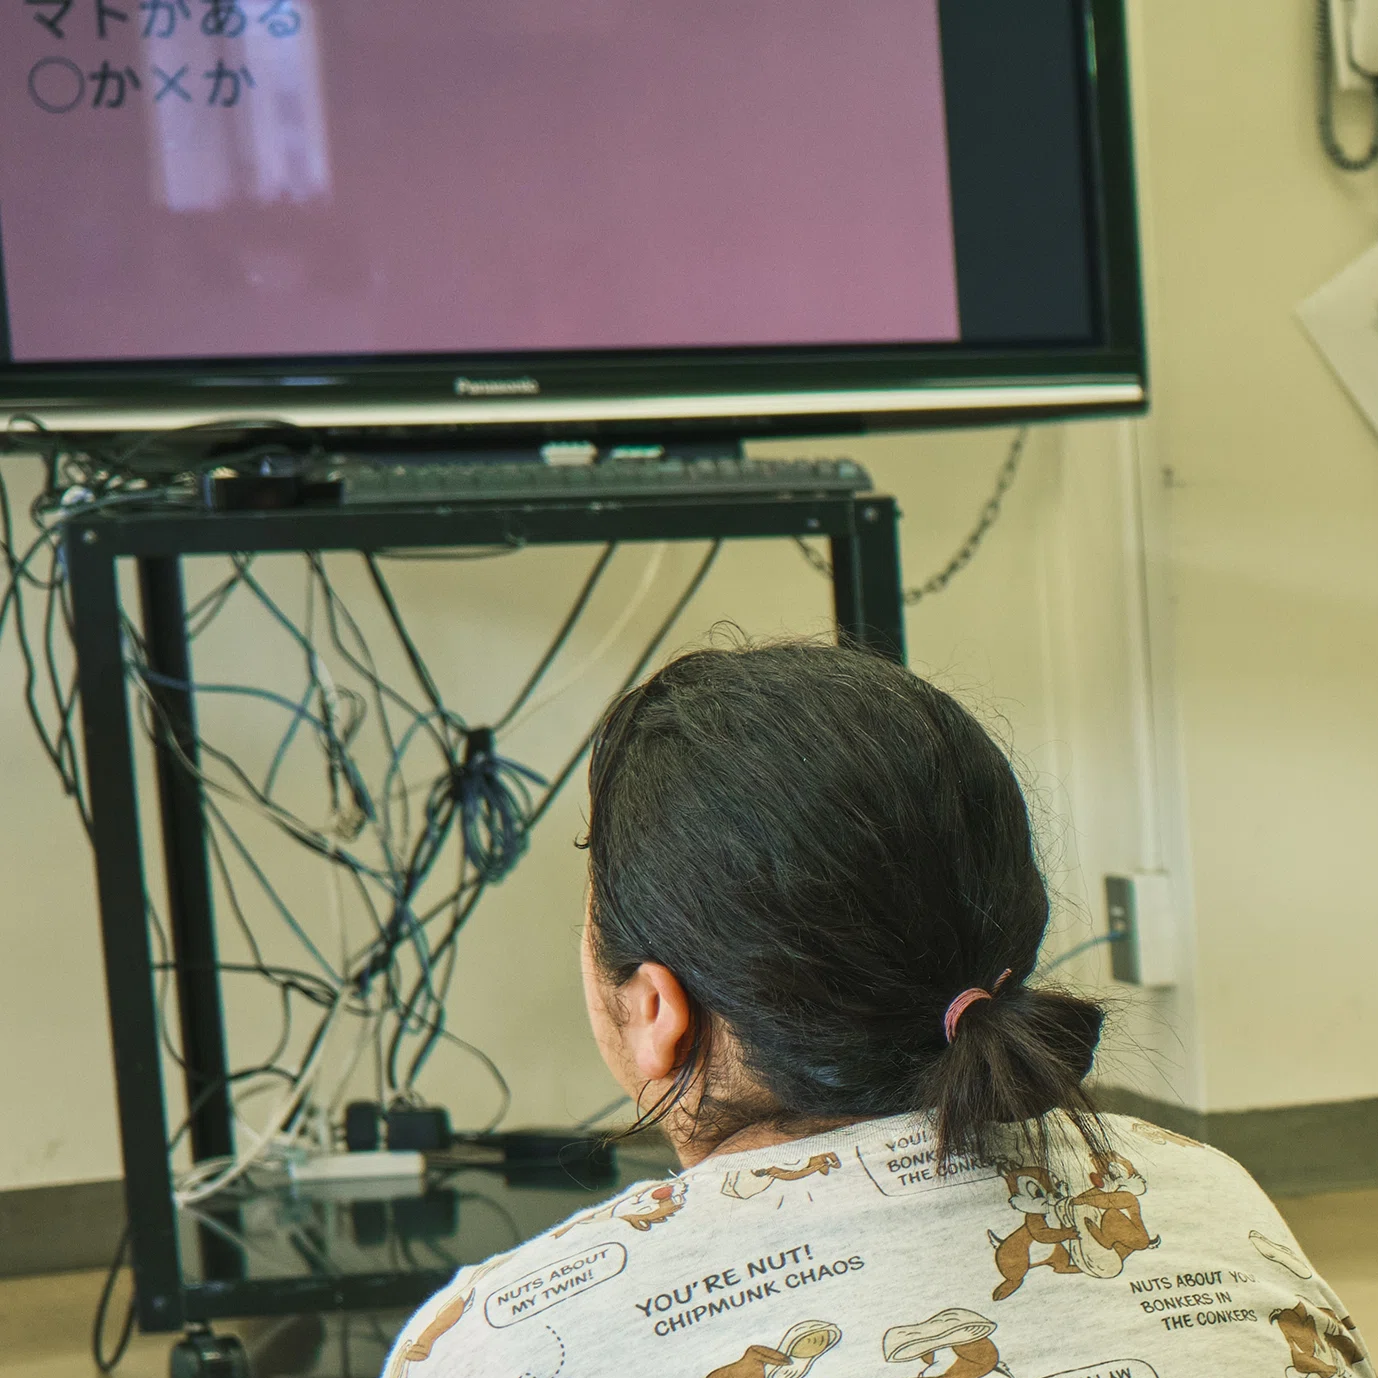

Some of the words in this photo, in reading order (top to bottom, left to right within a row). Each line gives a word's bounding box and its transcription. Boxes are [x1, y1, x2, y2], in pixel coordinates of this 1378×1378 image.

[886, 1130, 927, 1152] YOU!
[897, 1168, 933, 1187] THE
[497, 1278, 543, 1306] NUTS
[549, 1249, 609, 1282] ABOUT
[636, 1268, 742, 1318] YOU'RE
[747, 1244, 813, 1279] NUT!
[1129, 1277, 1172, 1294] NUTS
[1176, 1271, 1222, 1288] ABOUT
[512, 1294, 537, 1316] MY
[542, 1269, 595, 1300] TWIN!
[654, 1280, 781, 1337] CHIPMUNK
[784, 1255, 865, 1289] CHAOS
[1140, 1293, 1214, 1314] BONKERS
[1215, 1291, 1232, 1304] IN
[1161, 1313, 1194, 1331] THE
[1196, 1308, 1258, 1326] CONKERS
